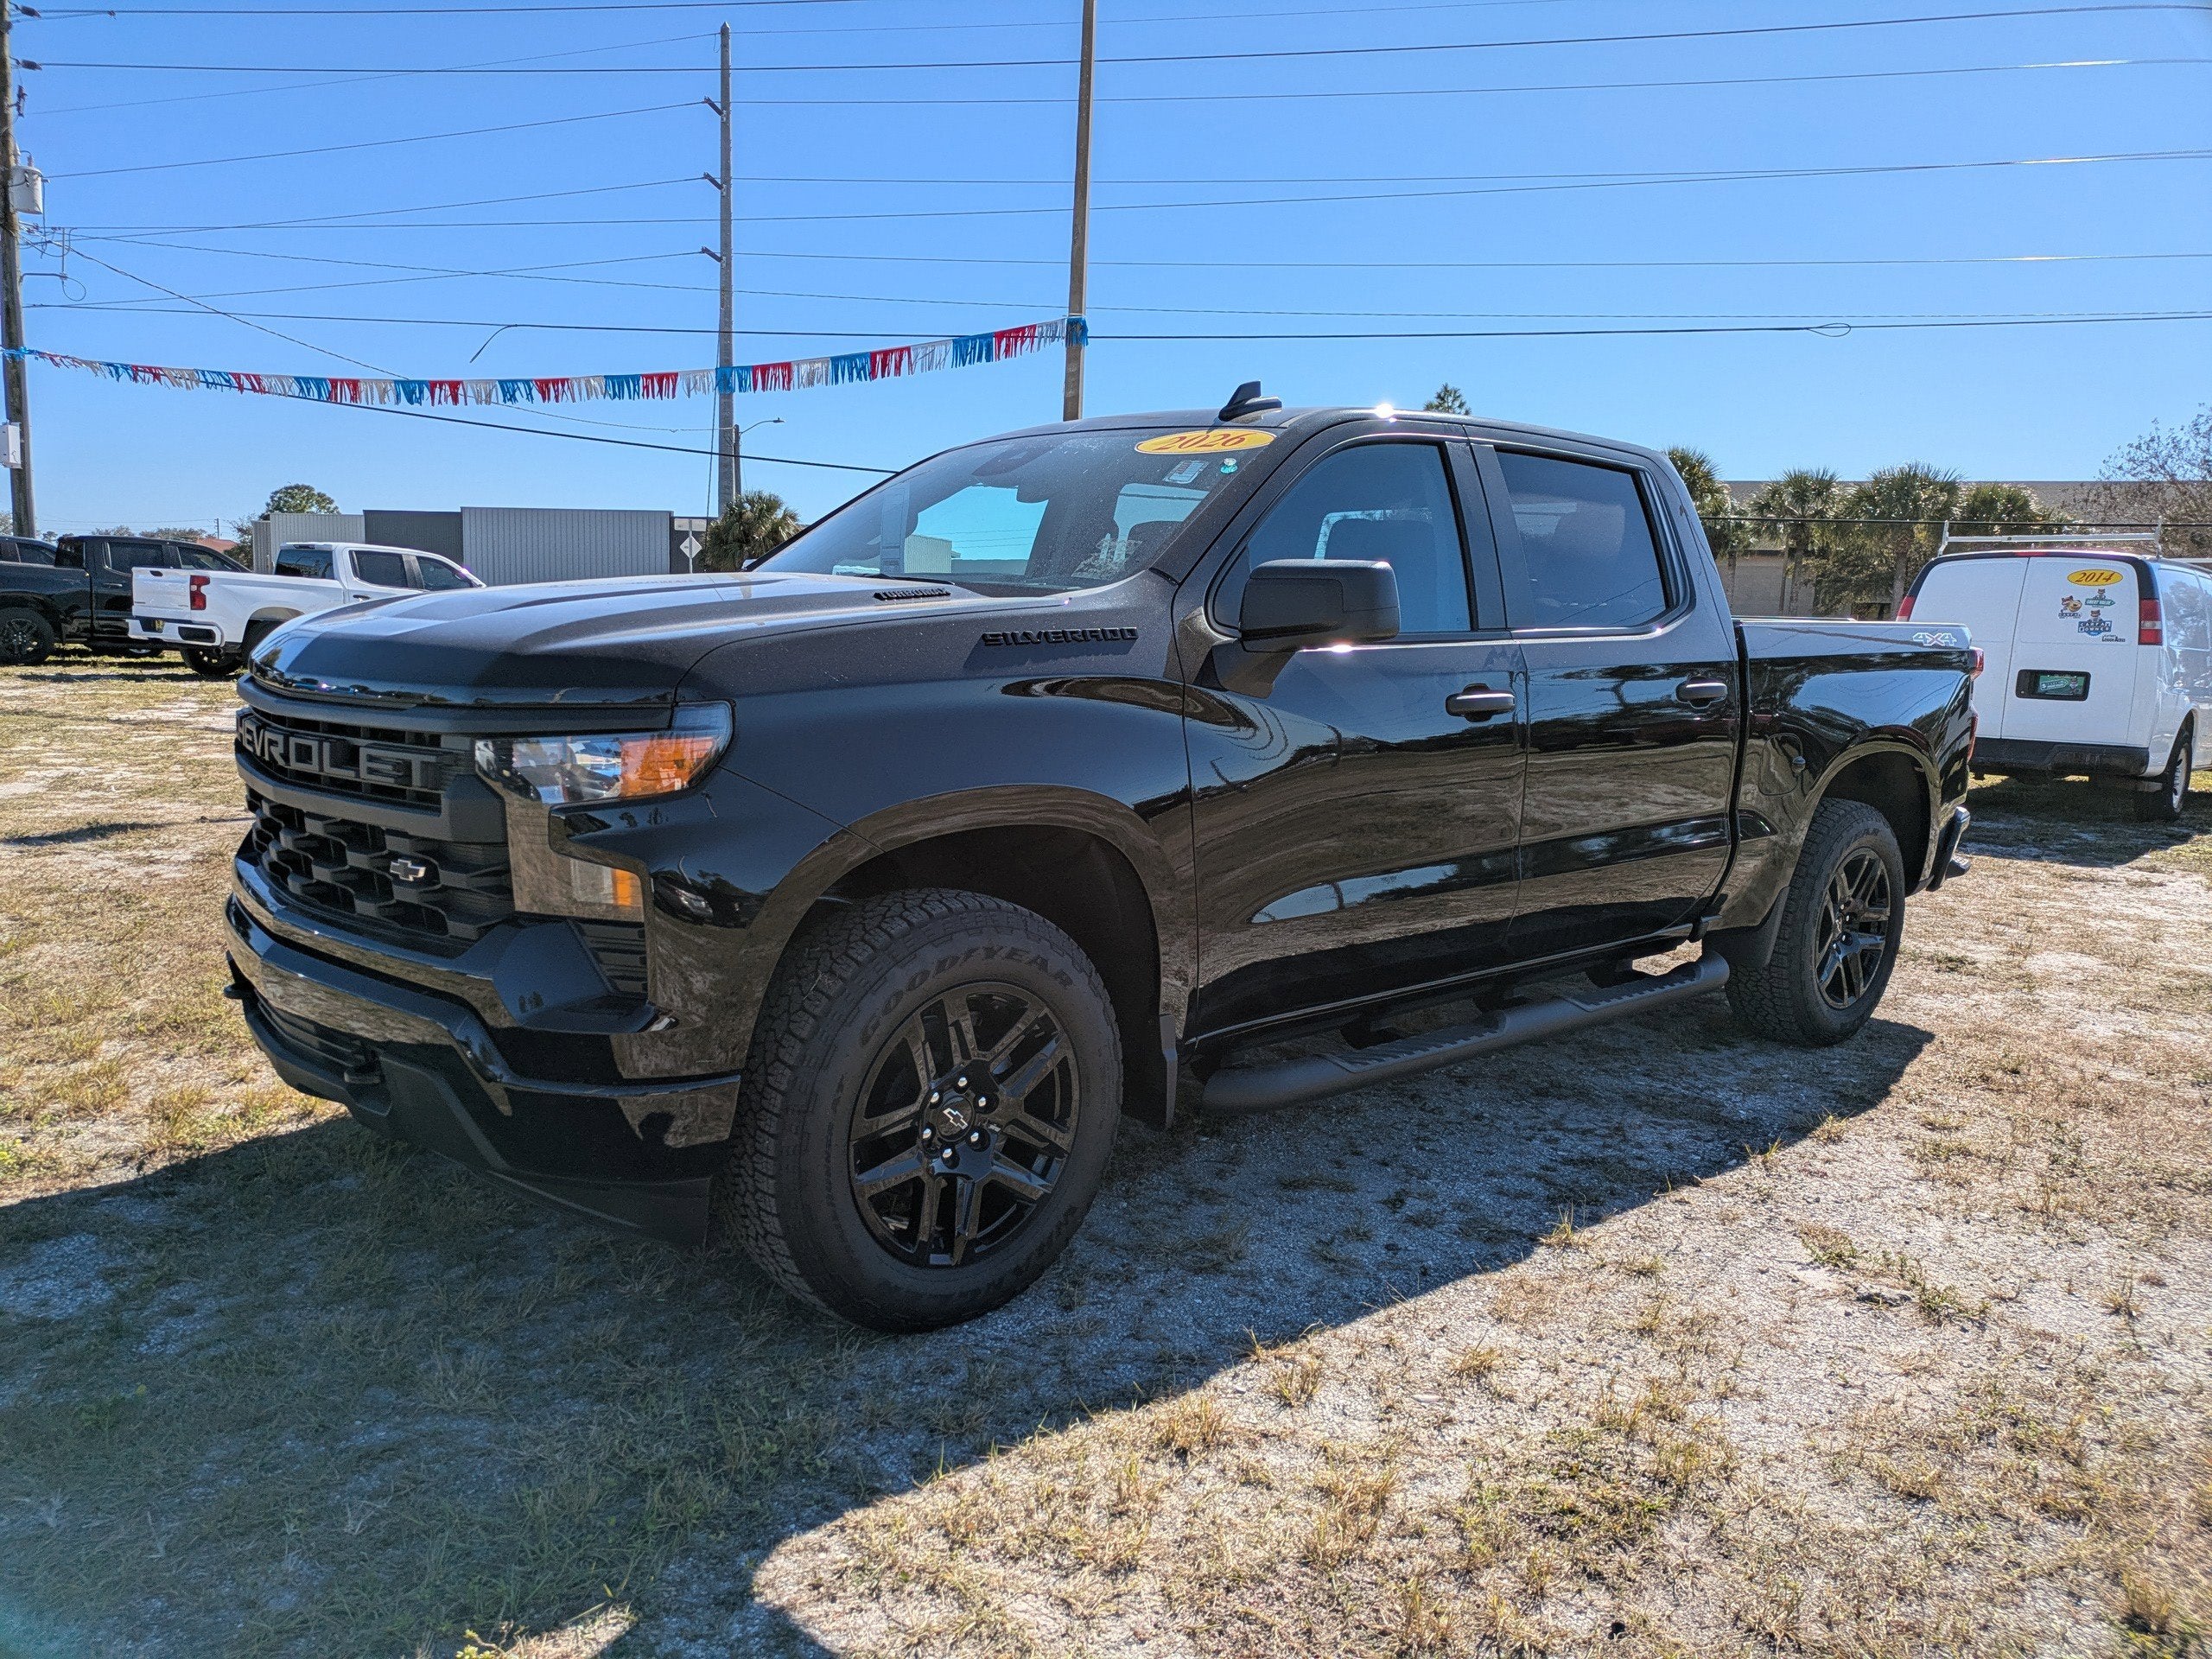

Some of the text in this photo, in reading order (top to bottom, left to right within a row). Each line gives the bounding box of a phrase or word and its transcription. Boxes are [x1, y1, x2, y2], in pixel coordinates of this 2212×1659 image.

[1152, 432, 1257, 452] 2026
[2075, 571, 2115, 583] 2014
[982, 627, 1139, 646] SILVERADO
[236, 715, 438, 787] HEVROLET
[860, 945, 1074, 1046] GOODYEAR
